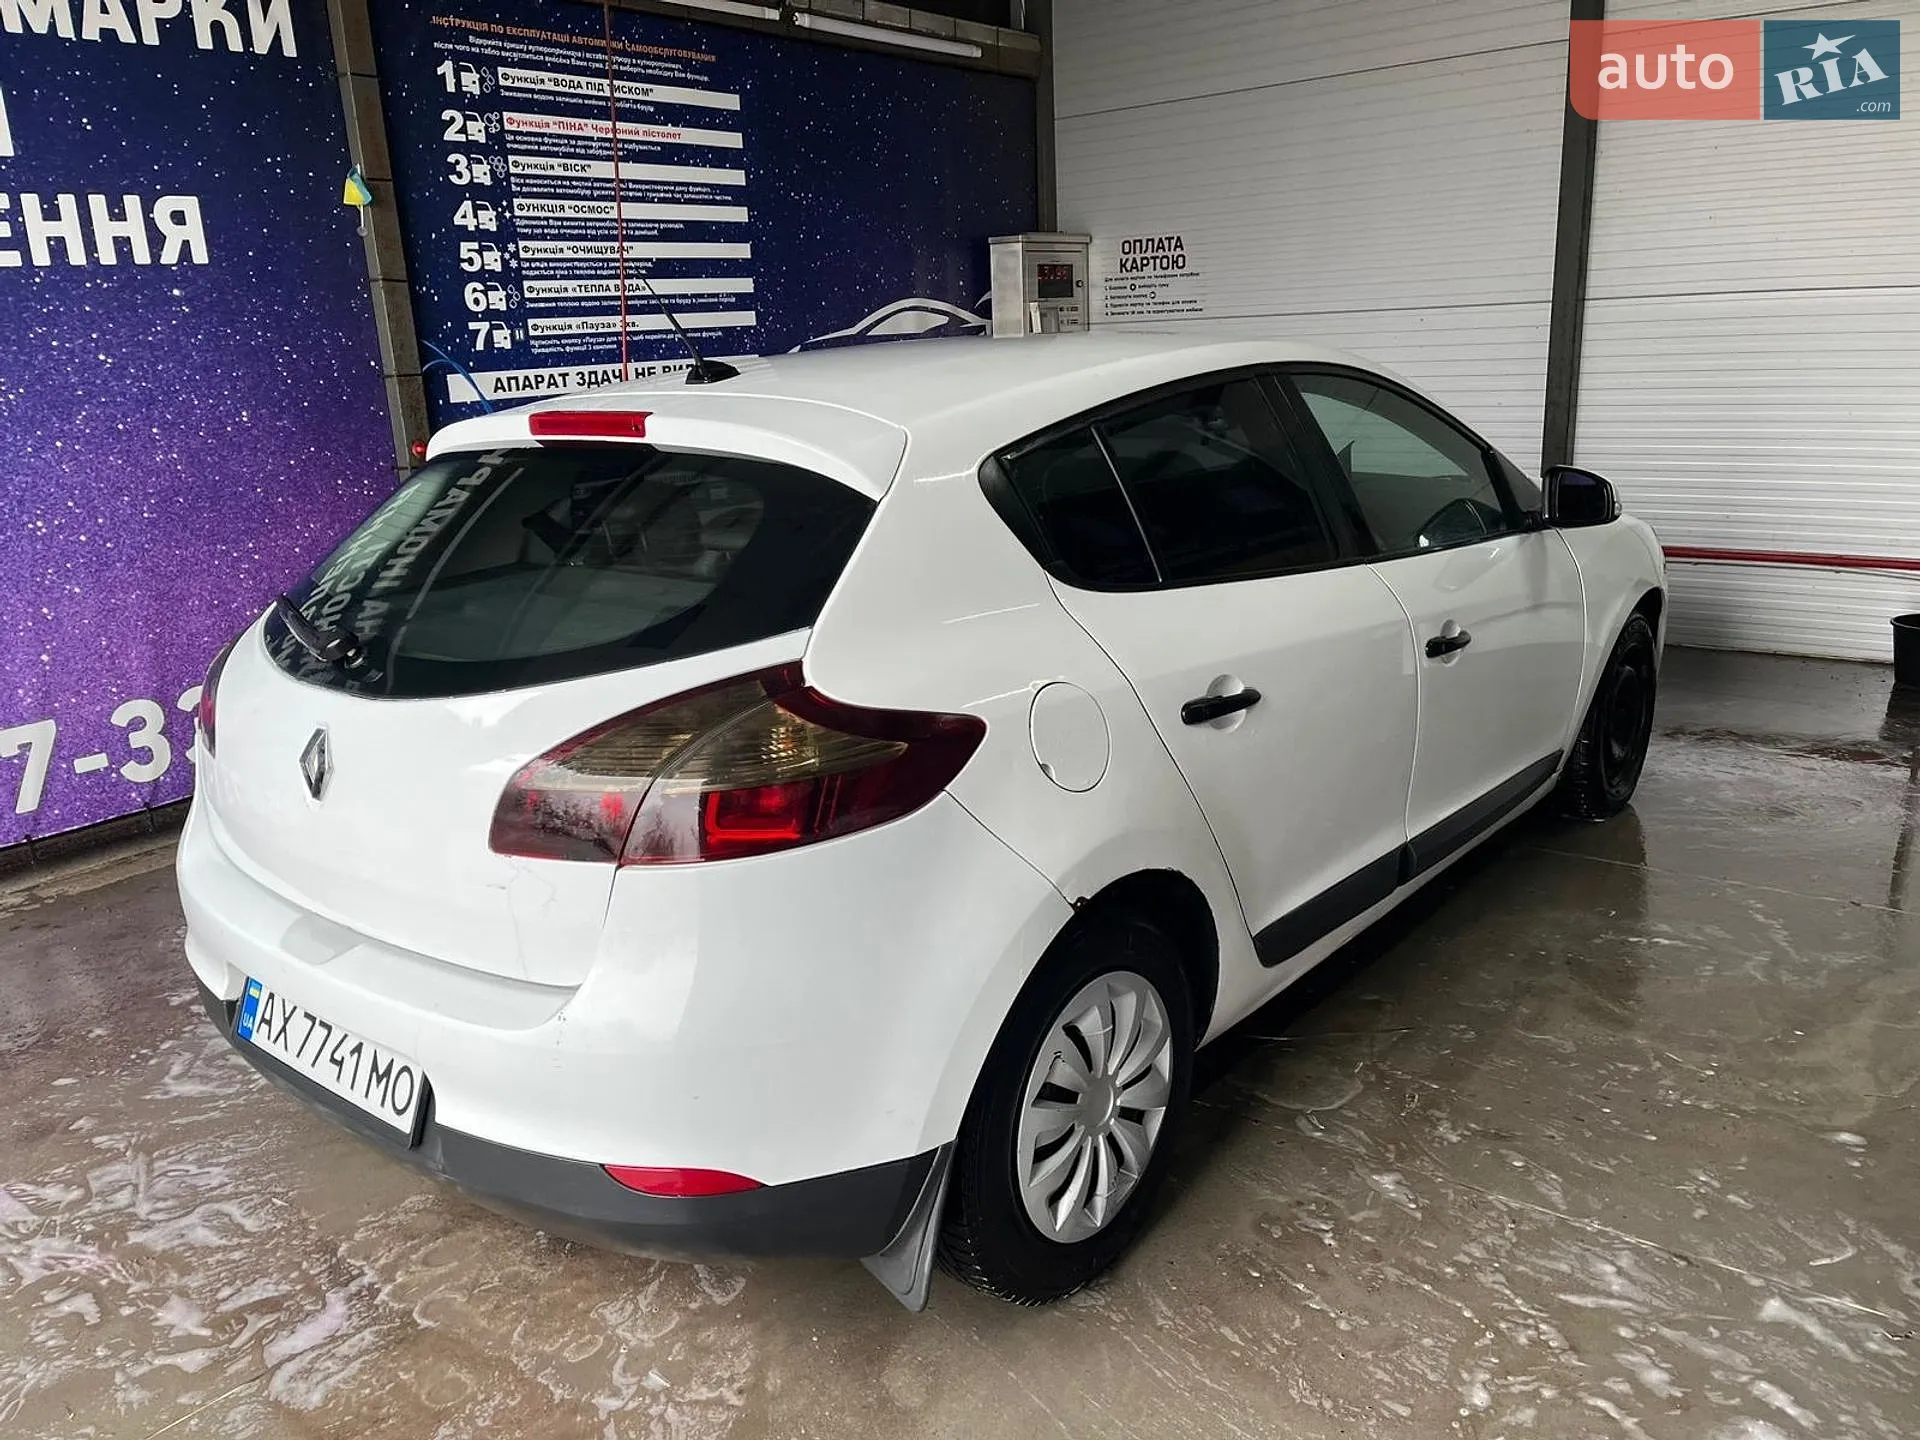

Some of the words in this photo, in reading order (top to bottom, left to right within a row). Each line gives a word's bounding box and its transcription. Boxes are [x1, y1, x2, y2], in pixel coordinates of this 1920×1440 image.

[490, 23, 504, 34] ПО
[436, 60, 456, 93] 1
[501, 72, 545, 84] Функція
[586, 81, 605, 94] ПІД
[442, 110, 467, 142] 2
[506, 117, 550, 129] Функція
[642, 129, 681, 140] пістолет
[447, 153, 472, 185] 3
[511, 160, 555, 172] Функція
[453, 200, 478, 231] 4
[516, 204, 565, 215] ФУНКЦІЯ
[459, 242, 482, 272] 5
[522, 245, 564, 256] Функція
[1122, 236, 1184, 255] ОПЛАТА
[1120, 254, 1186, 273] КАРТОЮ
[464, 282, 488, 312] 6
[526, 285, 568, 295] Функція
[468, 322, 490, 350] 7
[531, 323, 572, 333] Функція
[493, 373, 569, 393] АПАРАТ
[576, 368, 628, 388] ЗДАЧ
[257, 991, 298, 1053] AX
[303, 1011, 364, 1092] 7741
[364, 1048, 415, 1116] MO
